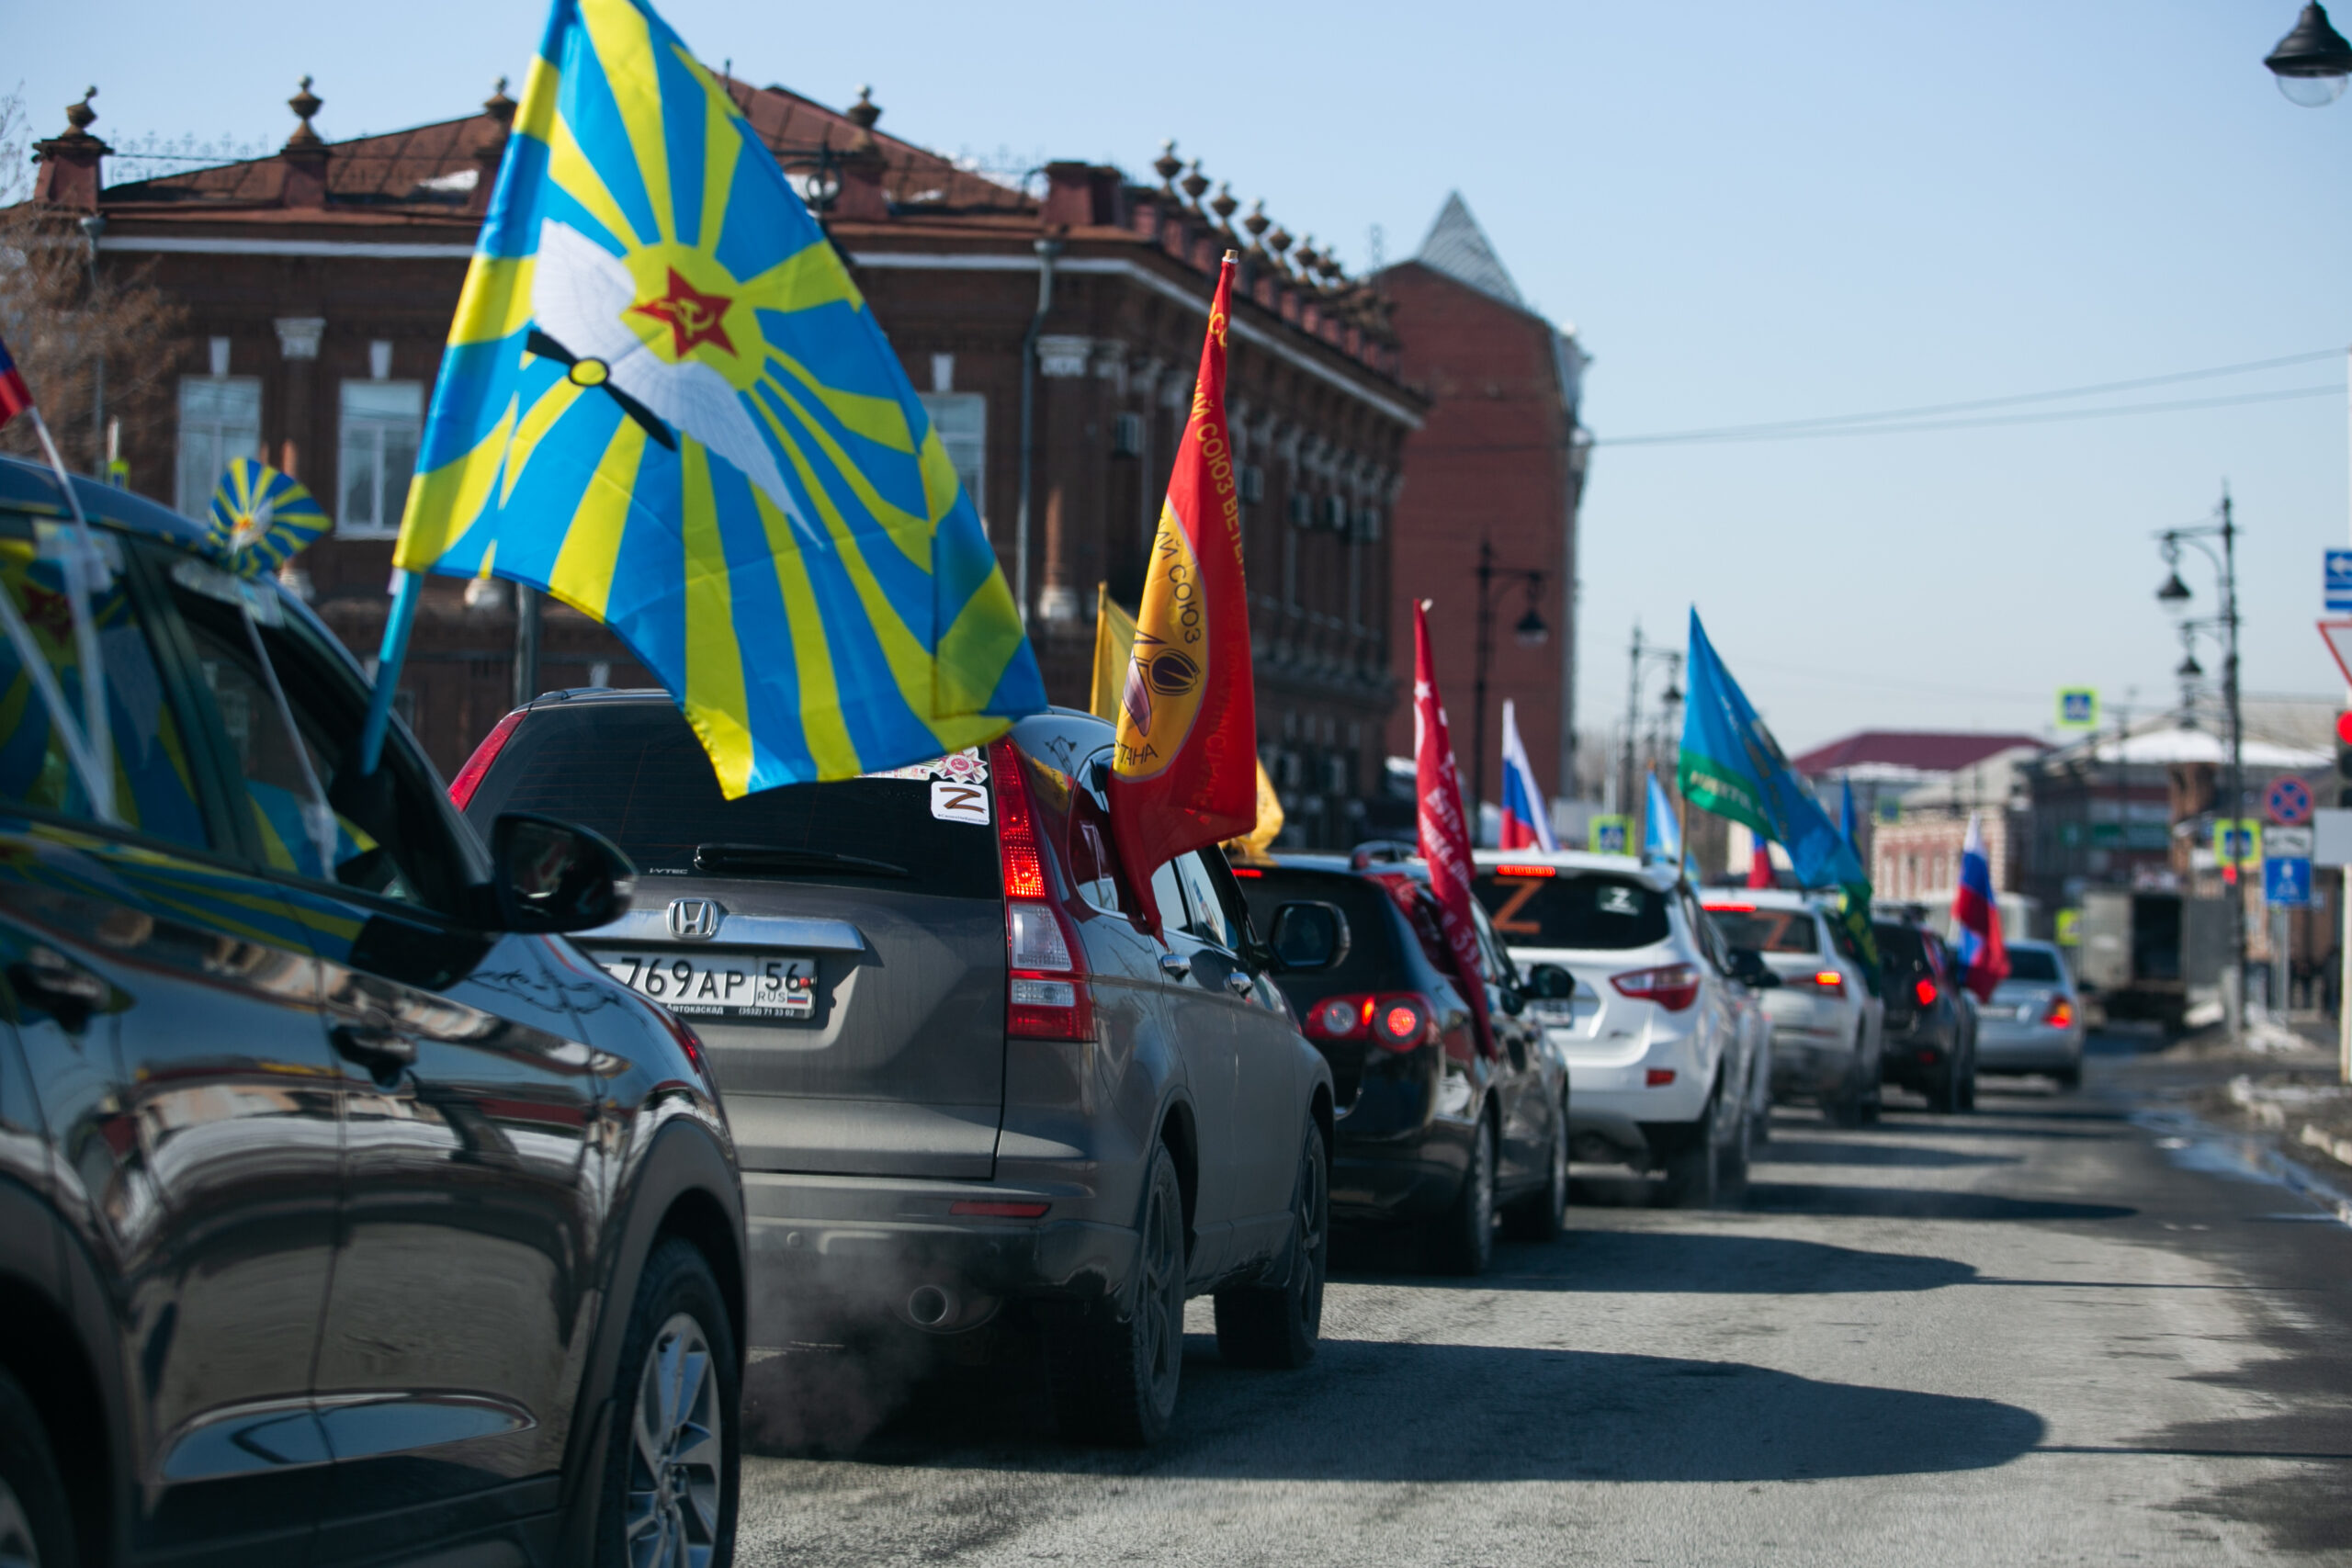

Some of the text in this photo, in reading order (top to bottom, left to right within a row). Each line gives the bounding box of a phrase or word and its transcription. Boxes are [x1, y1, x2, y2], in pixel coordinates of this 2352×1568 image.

[1196, 423, 1235, 496] СОЮЗ
[1168, 564, 1201, 644] СОЮЗ
[939, 786, 986, 814] Z
[1493, 876, 1545, 934] Z
[604, 957, 801, 999] 769АР 56
[757, 991, 786, 1004] RUS
[666, 1003, 724, 1015] Автокаскад
